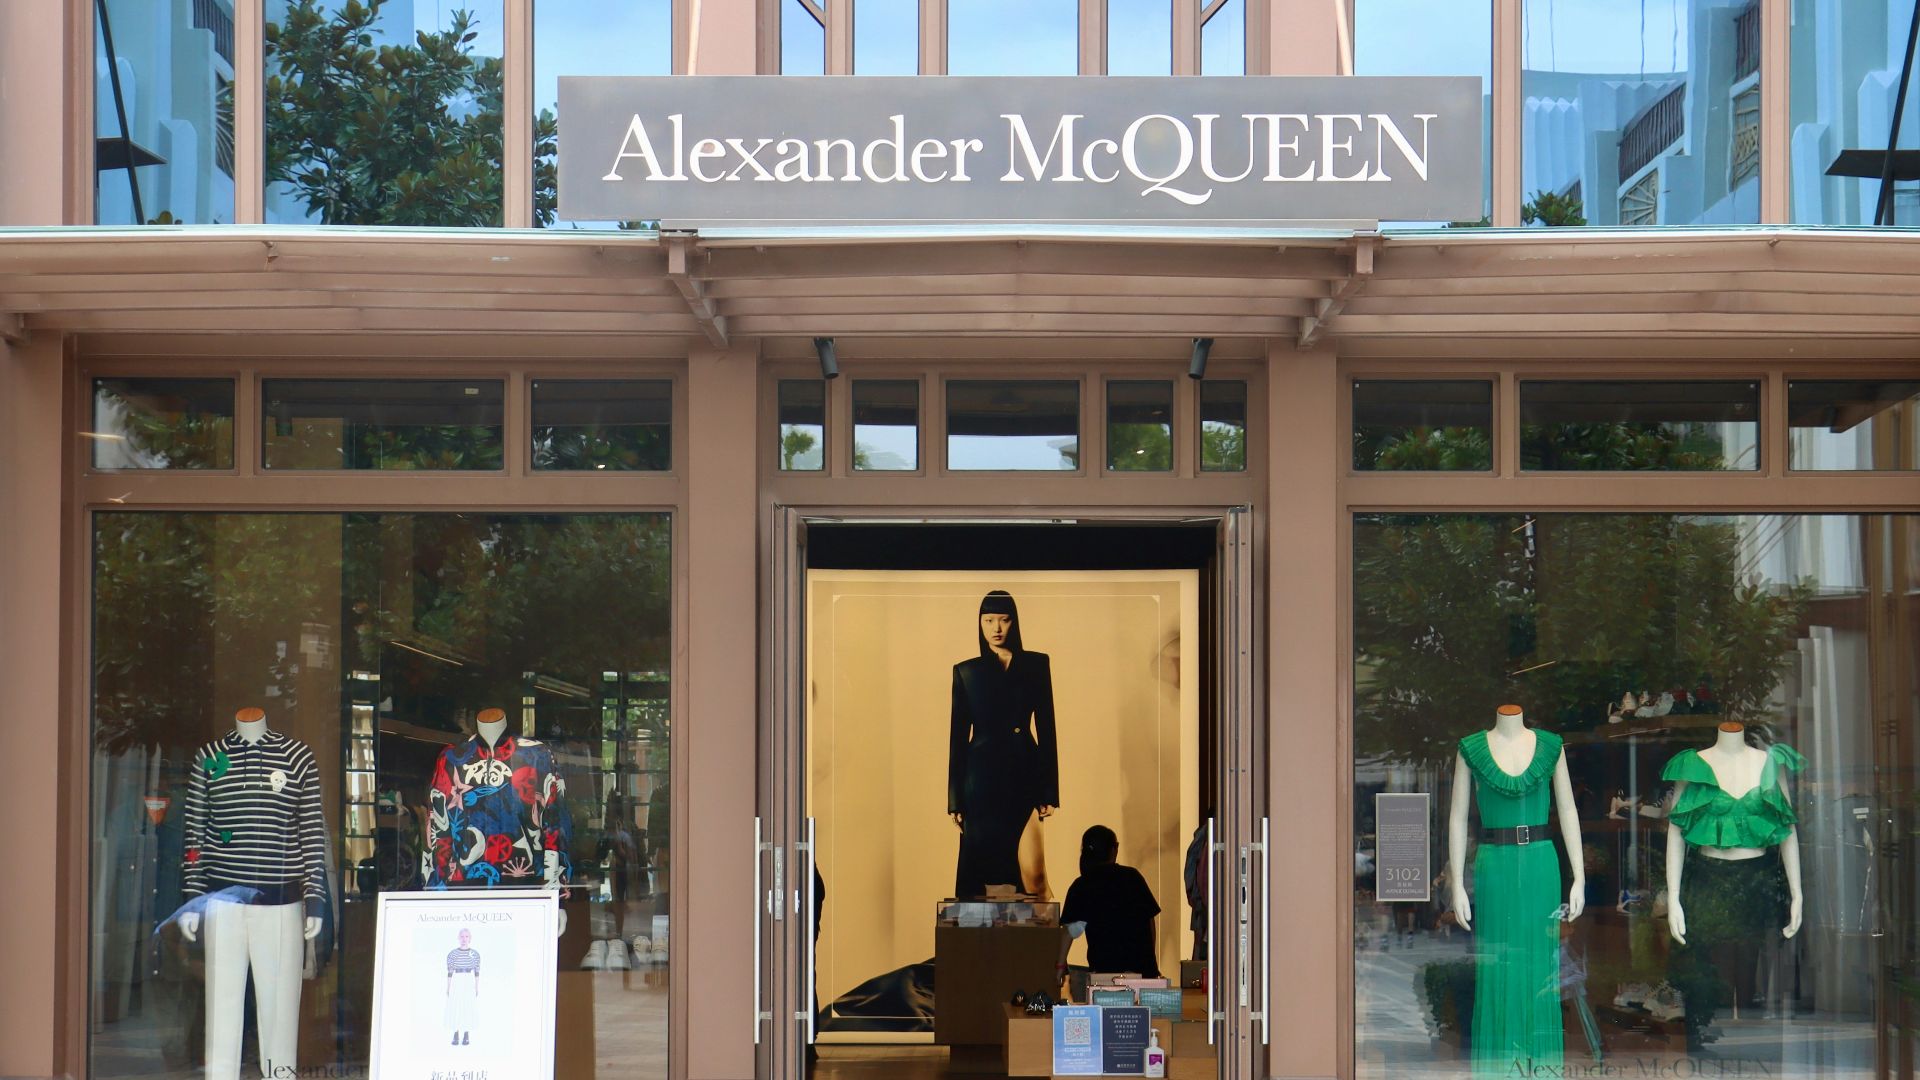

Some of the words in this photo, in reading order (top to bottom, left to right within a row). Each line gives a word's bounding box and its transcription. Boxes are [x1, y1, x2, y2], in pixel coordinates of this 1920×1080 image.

[602, 114, 984, 183] Alexander
[1000, 114, 1438, 205] McQUEEN
[1385, 868, 1421, 881] 3102
[417, 912, 461, 922] Alexander
[462, 911, 513, 924] McQUEEN
[1506, 1056, 1629, 1079] Alexander
